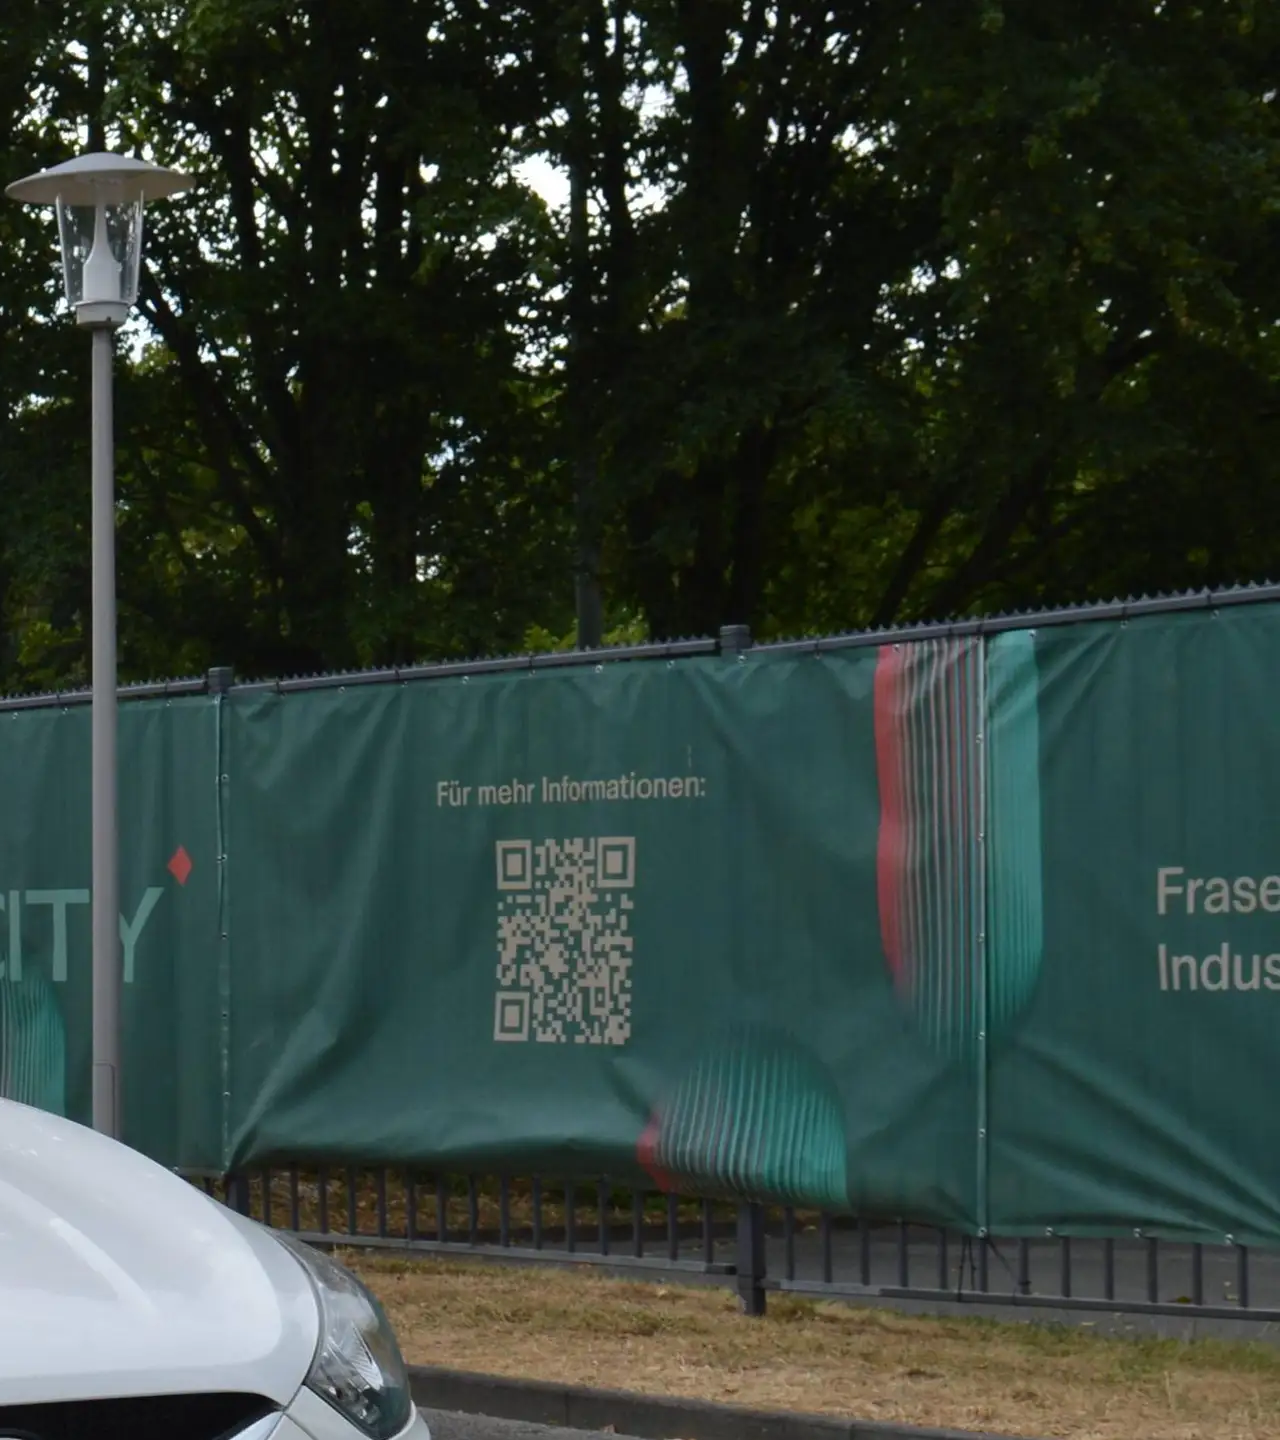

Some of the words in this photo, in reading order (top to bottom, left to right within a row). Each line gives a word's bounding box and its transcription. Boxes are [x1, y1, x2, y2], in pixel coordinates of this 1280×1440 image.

[437, 780, 472, 807] Für
[478, 779, 535, 805] mehr
[542, 771, 706, 803] Informationen:
[1157, 866, 1280, 915] Frase
